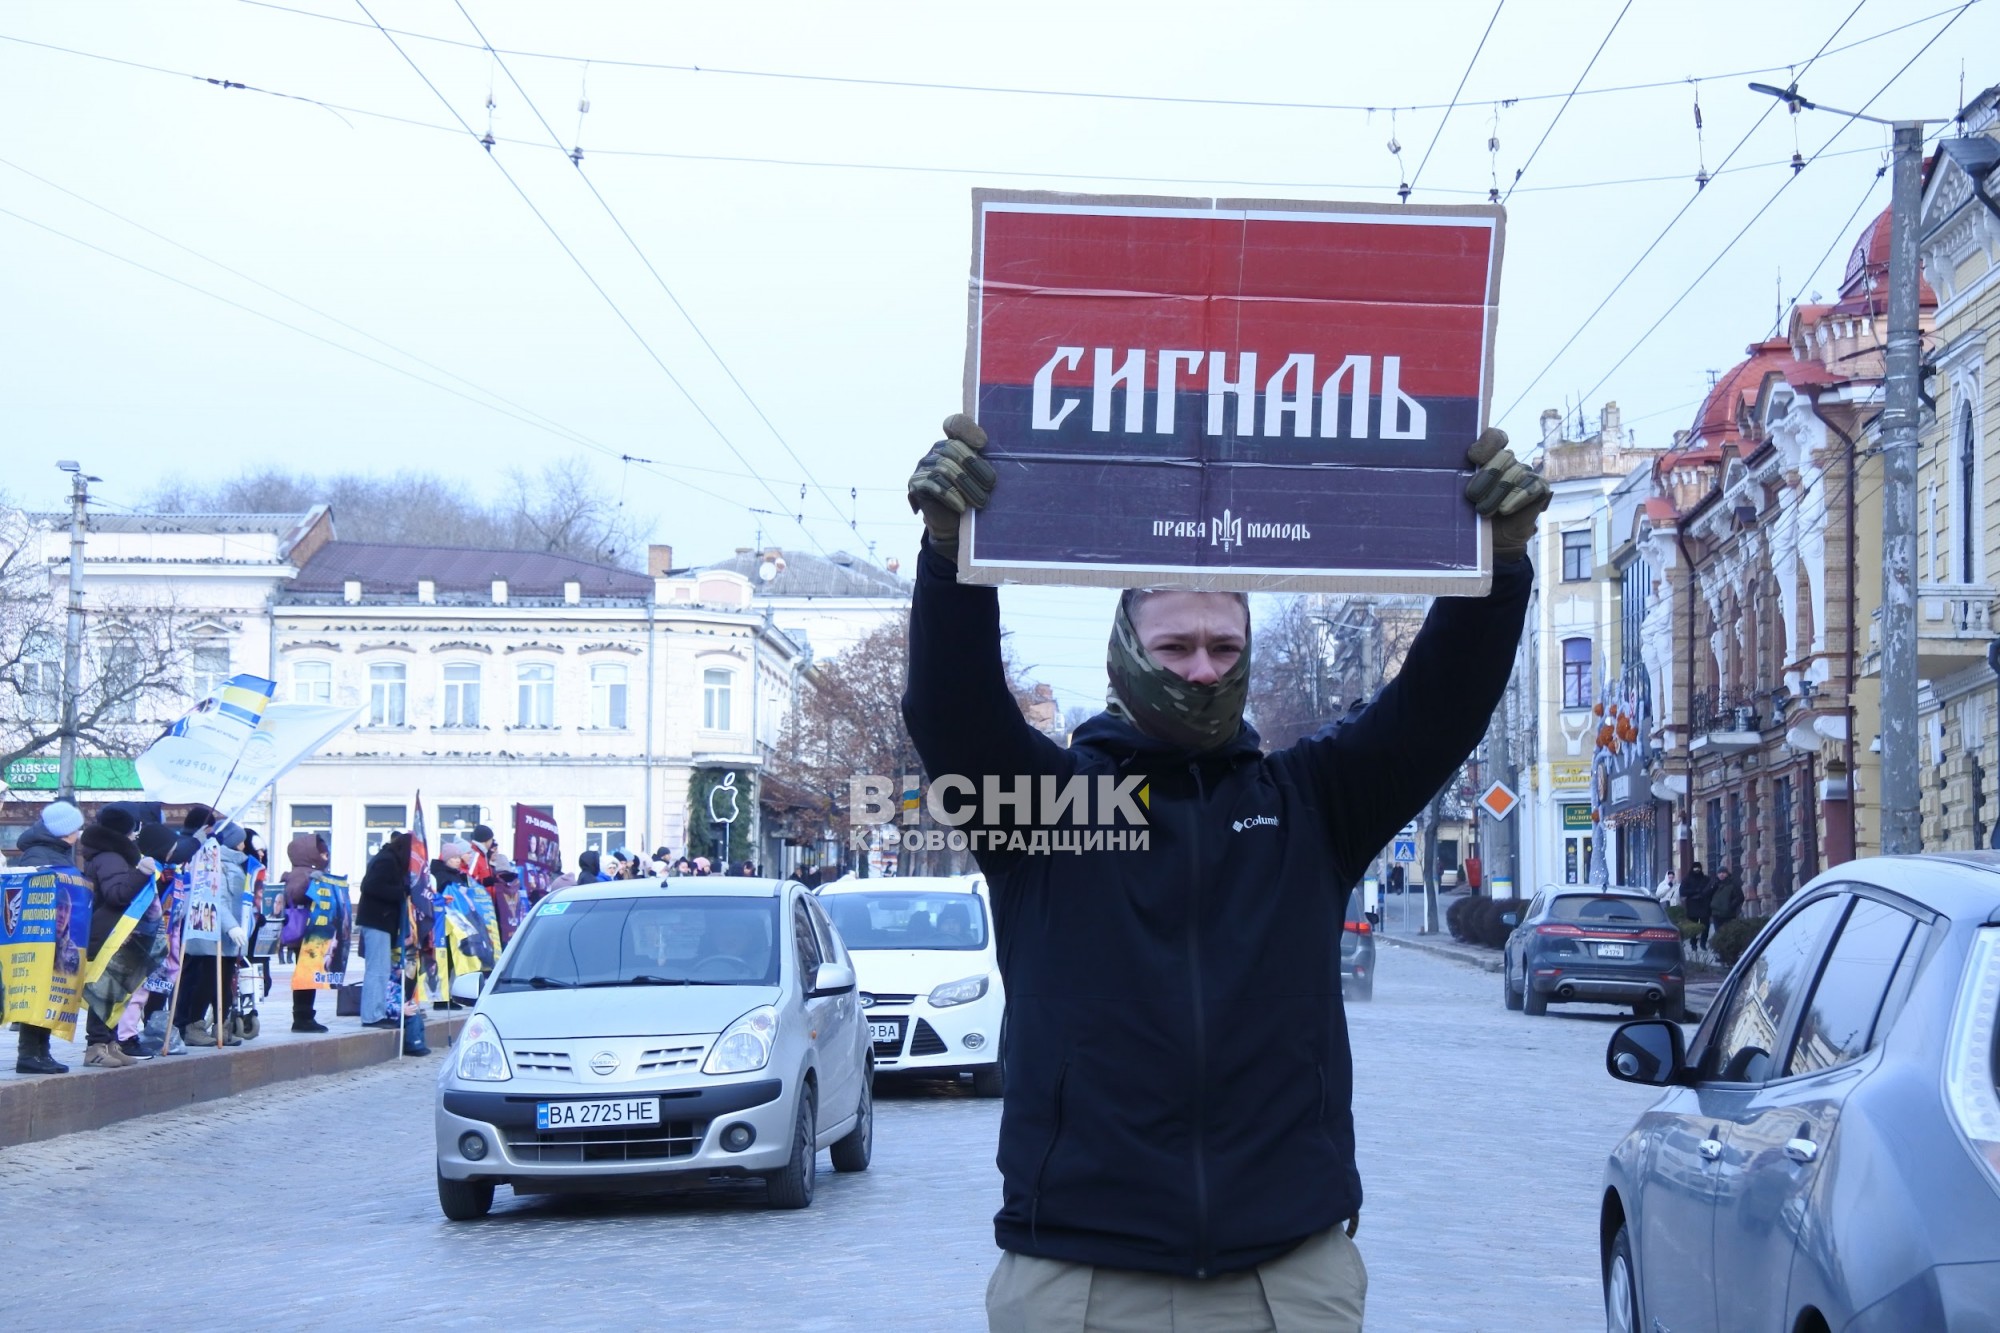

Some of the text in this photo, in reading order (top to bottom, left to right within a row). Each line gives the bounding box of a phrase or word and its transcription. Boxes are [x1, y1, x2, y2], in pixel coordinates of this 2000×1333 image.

[1032, 346, 1427, 440] СИГНАЛЬ
[1153, 521, 1311, 541] ПРАВА МОЛОДЬ
[878, 1025, 896, 1037] BA
[550, 1101, 653, 1124] BA 2725 HE
